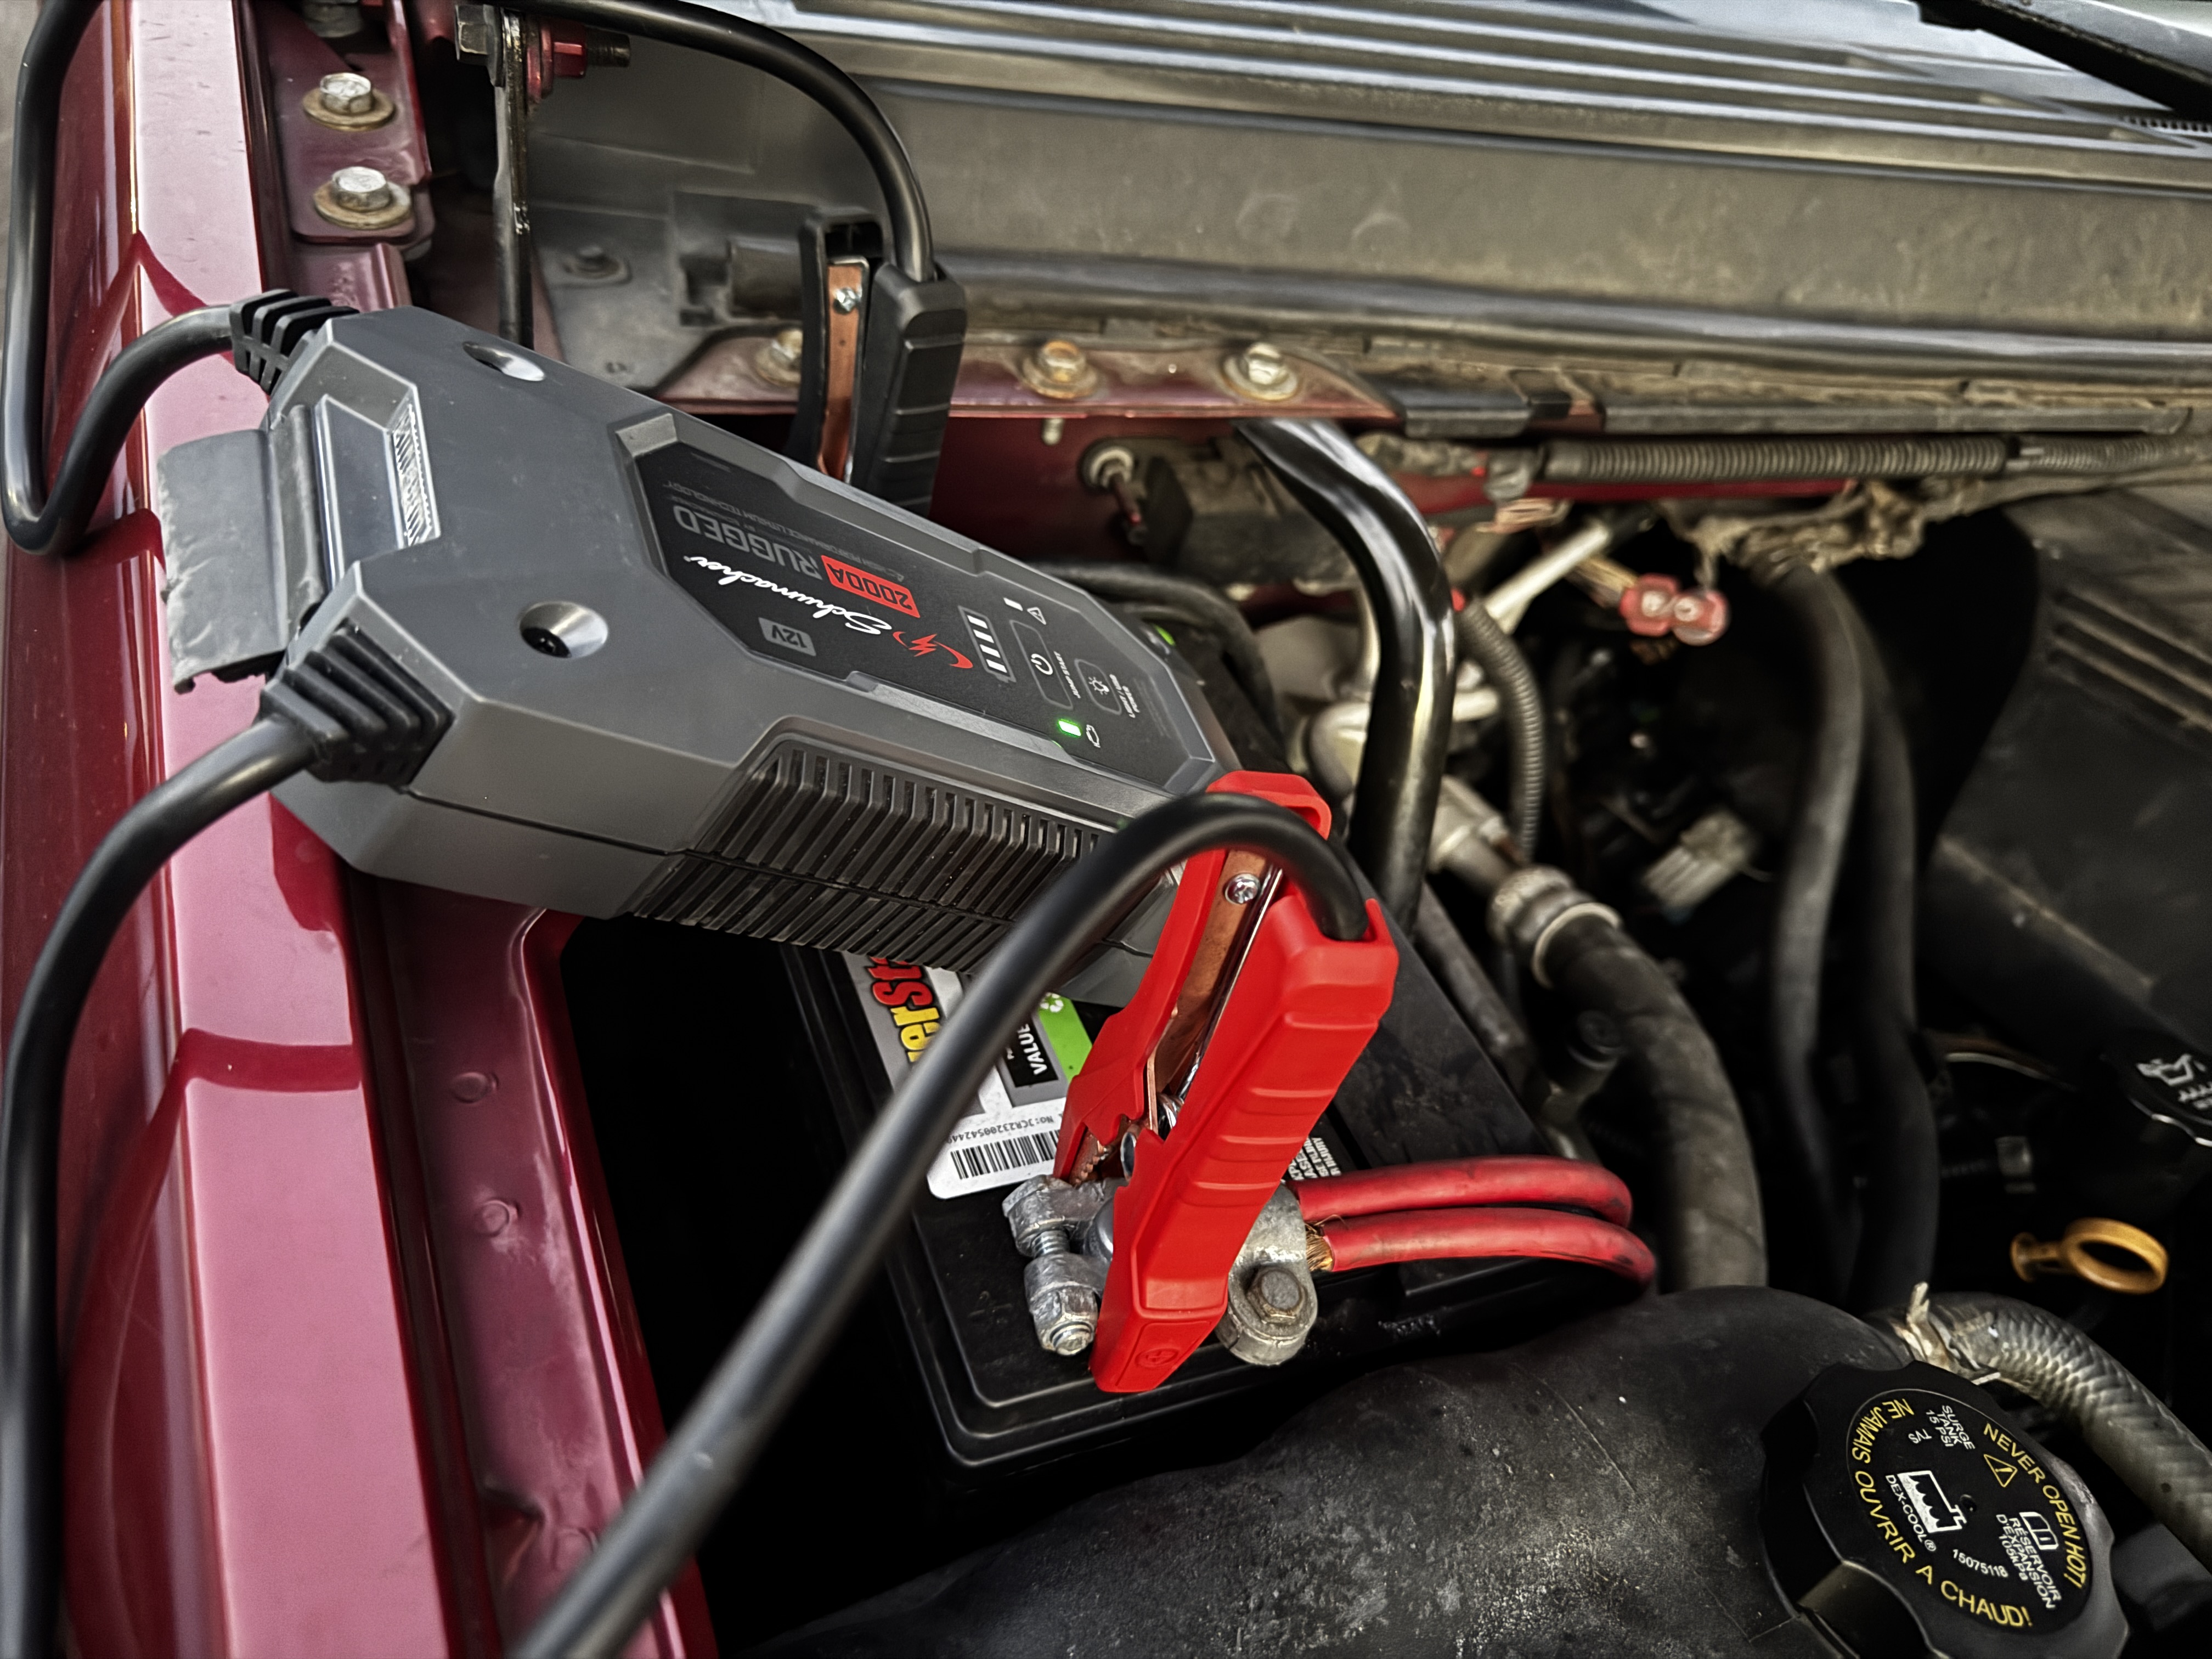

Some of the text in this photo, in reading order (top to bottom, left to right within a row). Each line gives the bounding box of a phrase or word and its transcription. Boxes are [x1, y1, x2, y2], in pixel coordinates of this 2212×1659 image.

[673, 505, 823, 581] RUGGED
[688, 556, 893, 635] Schumacher
[826, 563, 913, 610] 2000A
[771, 624, 808, 649] 12V
[1053, 650, 1070, 676] START
[1908, 1429, 1932, 1444] TVS
[1926, 1409, 1954, 1447] 15 PSI
[1937, 1412, 1963, 1445] TANK
[1942, 1405, 1976, 1450] SURGE
[1852, 1398, 2033, 1627] NE JAMAIS OUVRIR A CHAUD!
[1983, 1423, 2086, 1589] NEVER OPEN HOT!
[1953, 1549, 2008, 1578] 15075118
[1996, 1514, 2056, 1609] D'EXPANSION
[2008, 1517, 2062, 1601] RÉSERVOIR
